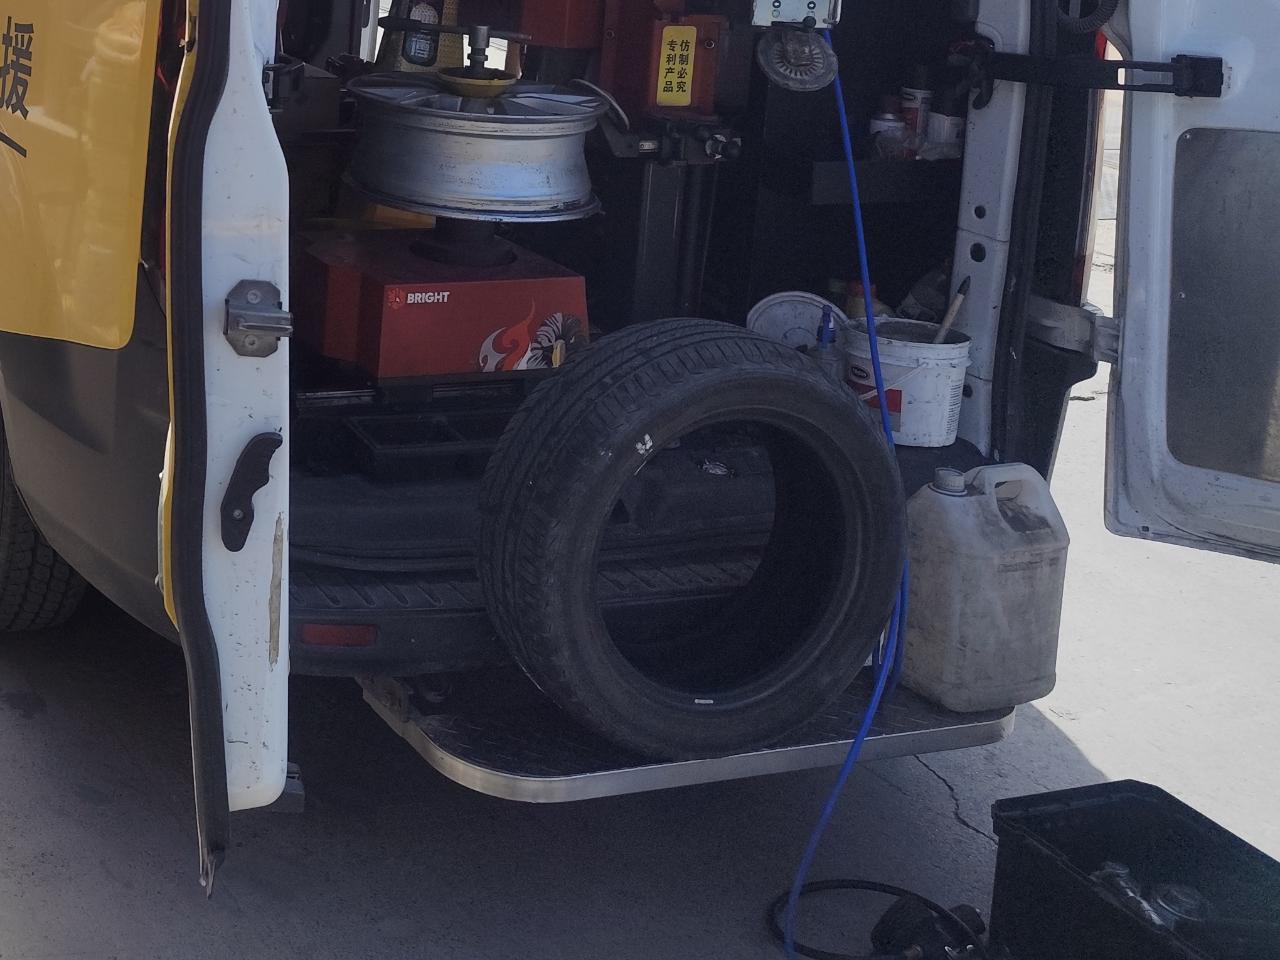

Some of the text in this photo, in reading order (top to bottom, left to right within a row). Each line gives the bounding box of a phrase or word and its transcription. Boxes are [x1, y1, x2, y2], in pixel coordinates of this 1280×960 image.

[663, 39, 678, 93] 专利产品
[676, 39, 690, 93] 仿制必究
[406, 291, 450, 304] BRIGHT
